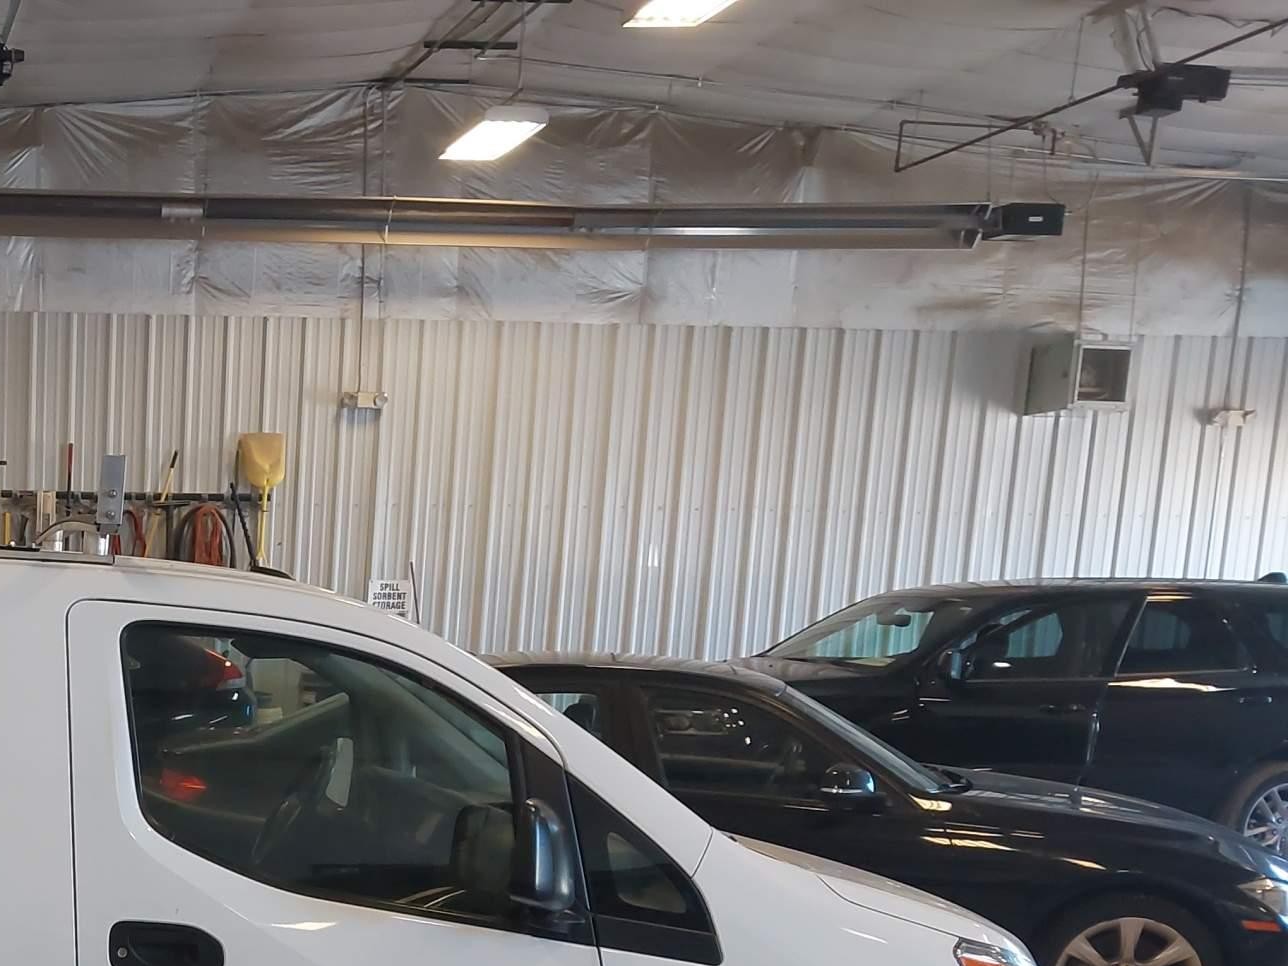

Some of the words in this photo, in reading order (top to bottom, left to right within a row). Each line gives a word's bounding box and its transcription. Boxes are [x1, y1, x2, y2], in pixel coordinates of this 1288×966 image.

[380, 583, 400, 591] SPILL
[373, 592, 407, 600] SORBENT
[373, 601, 406, 610] STORAGE
